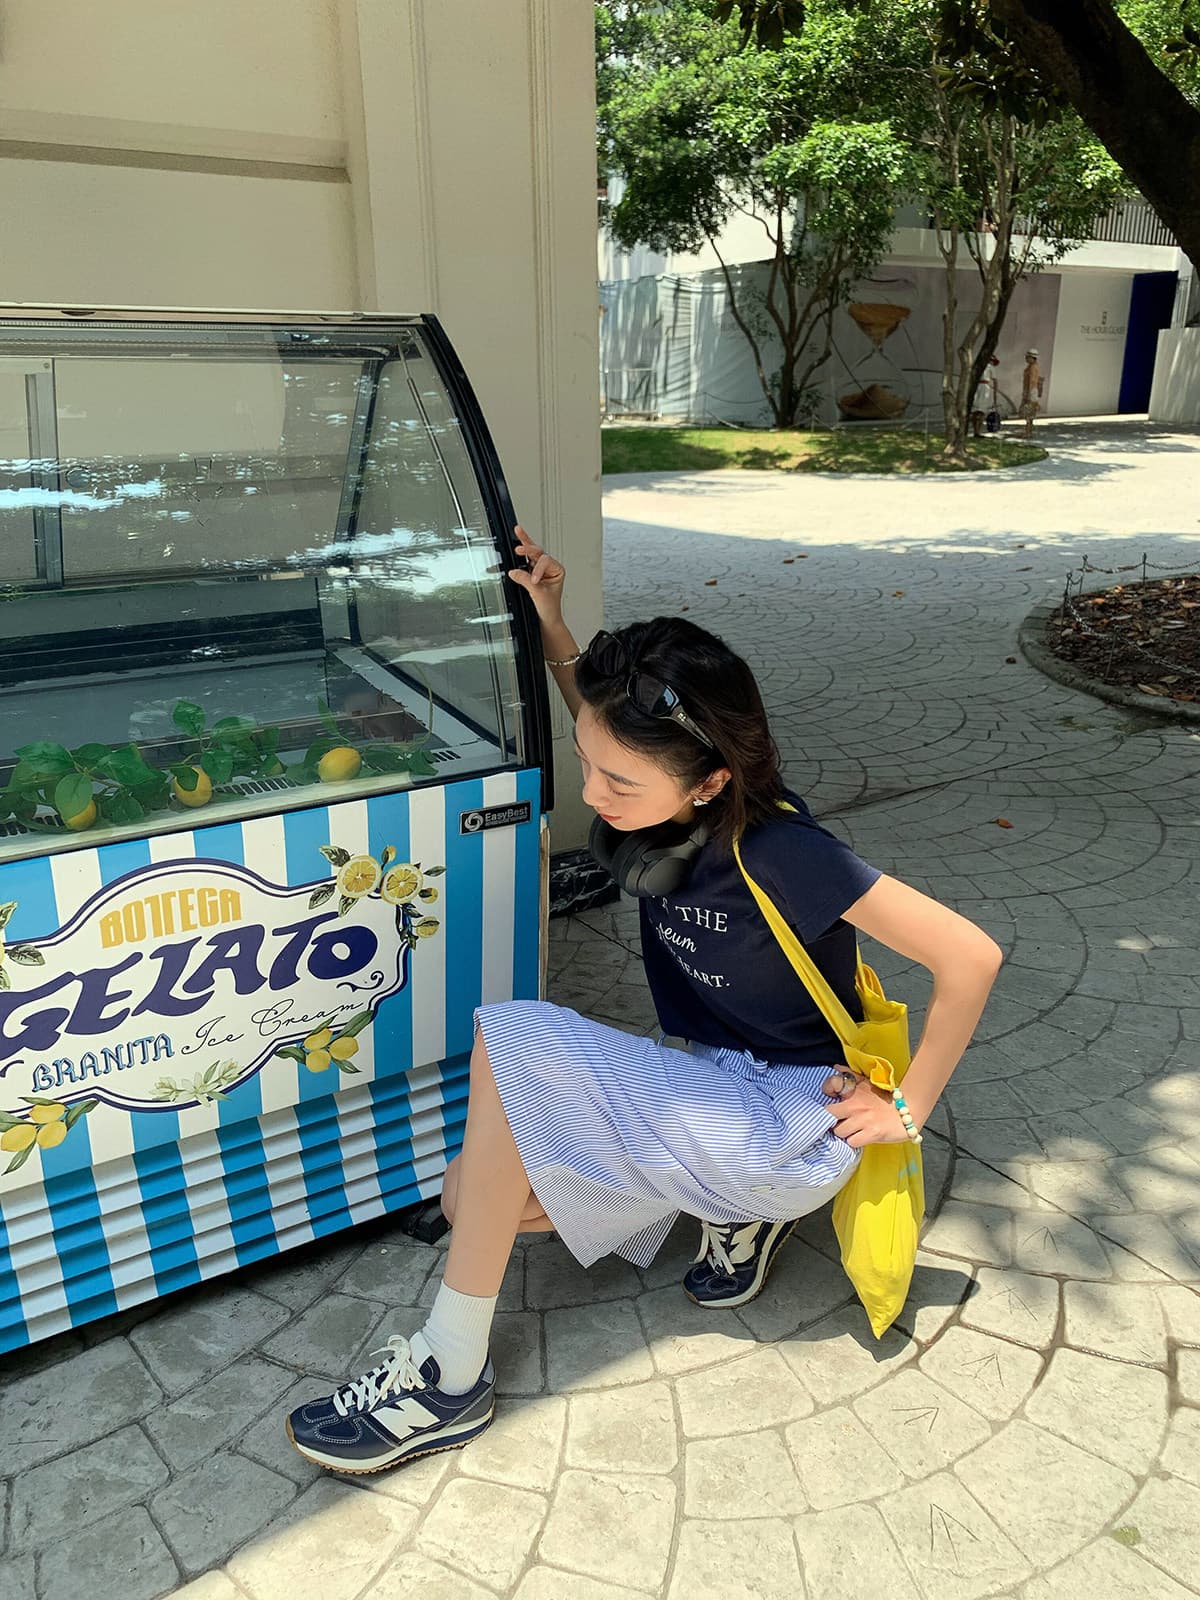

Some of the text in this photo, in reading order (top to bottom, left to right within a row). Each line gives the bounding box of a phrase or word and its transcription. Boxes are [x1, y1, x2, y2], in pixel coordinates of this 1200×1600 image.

[485, 806, 528, 822] EasyBest
[100, 888, 242, 949] BOTTEGA
[675, 905, 728, 932] THE
[0, 911, 379, 1061] GELATO
[31, 998, 364, 1093] GRANITA Ice Cream
